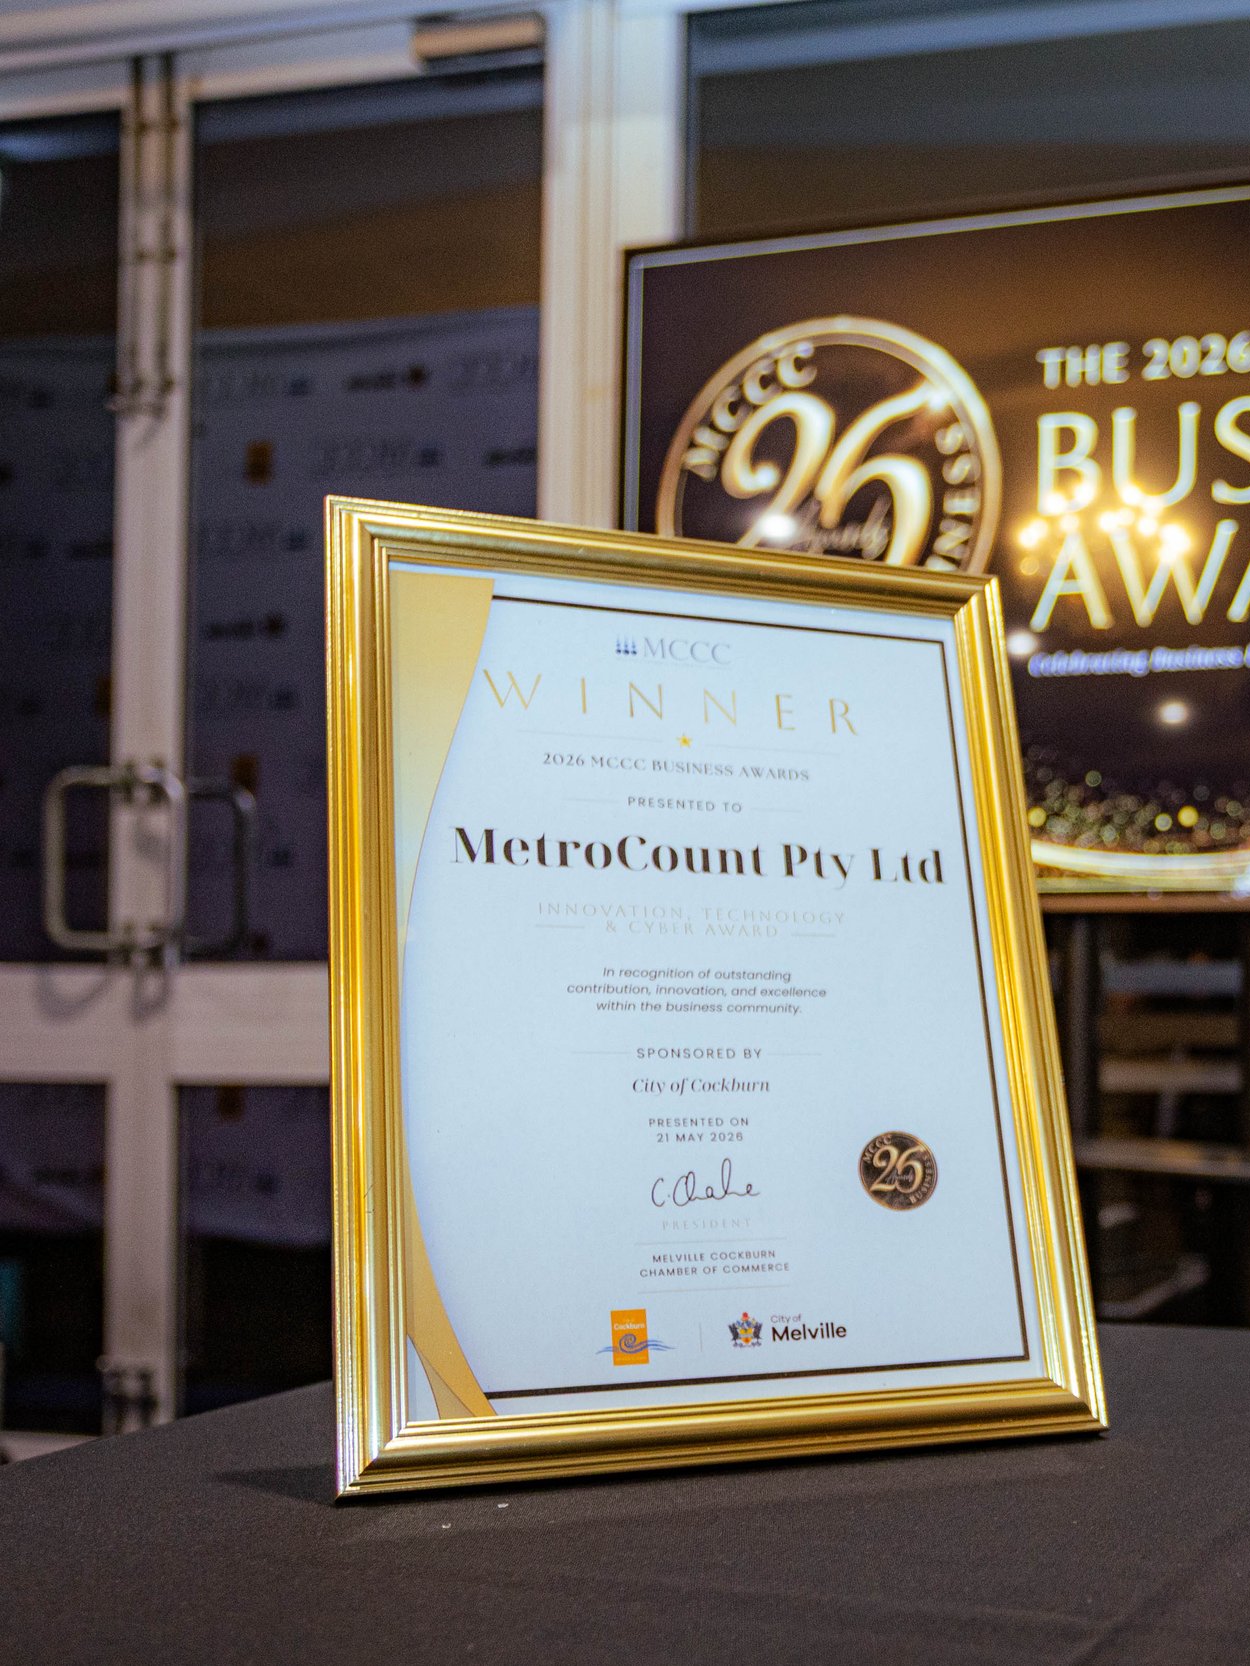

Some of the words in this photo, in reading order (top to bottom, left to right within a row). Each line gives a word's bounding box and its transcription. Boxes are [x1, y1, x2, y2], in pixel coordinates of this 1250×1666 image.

[1036, 341, 1131, 389] THE
[643, 637, 731, 666] MCCC
[484, 669, 859, 736] WINNER
[543, 752, 585, 768] 2026
[590, 755, 647, 772] MCCC
[652, 760, 734, 777] BUSINESS
[738, 765, 810, 782] AWARDS
[627, 796, 714, 812] PRESENTED
[721, 800, 743, 813] TO
[451, 826, 768, 877] MetroCount
[782, 843, 854, 890] Pty
[871, 848, 946, 886] Ltd
[538, 902, 693, 920] INNOVATION,
[703, 908, 846, 925] TECHNOLOGY
[628, 921, 694, 936] CYBER
[704, 924, 780, 938] AWARD
[602, 967, 615, 979] In
[618, 968, 694, 984] recognition
[698, 968, 711, 981] of
[714, 969, 792, 984] outstanding
[566, 982, 651, 996] contribution,
[655, 983, 727, 997] innovation,
[730, 984, 757, 997] and
[760, 985, 827, 998] excellence
[596, 999, 637, 1012] within
[640, 1000, 662, 1012] the
[665, 1000, 724, 1014] business
[726, 1002, 803, 1016] community.
[636, 1047, 737, 1060] SPONSORED
[742, 1047, 763, 1060] BY
[631, 1078, 666, 1095] City
[669, 1076, 688, 1095] of
[690, 1077, 771, 1094] Cockburn
[648, 1117, 724, 1129] PRESENTED
[729, 1117, 750, 1128] ON
[656, 1132, 670, 1143] 21
[674, 1132, 704, 1143] MAY
[709, 1131, 744, 1142] 2026
[661, 1217, 752, 1232] PRESIDENT
[652, 1253, 706, 1263] MELVILLE
[710, 1250, 776, 1262] COCKBURN
[639, 1267, 698, 1279] CHAMBER
[703, 1266, 718, 1276] OF
[722, 1263, 790, 1275] COMMERCE
[771, 1314, 793, 1325] City
[770, 1320, 848, 1344] Melville
